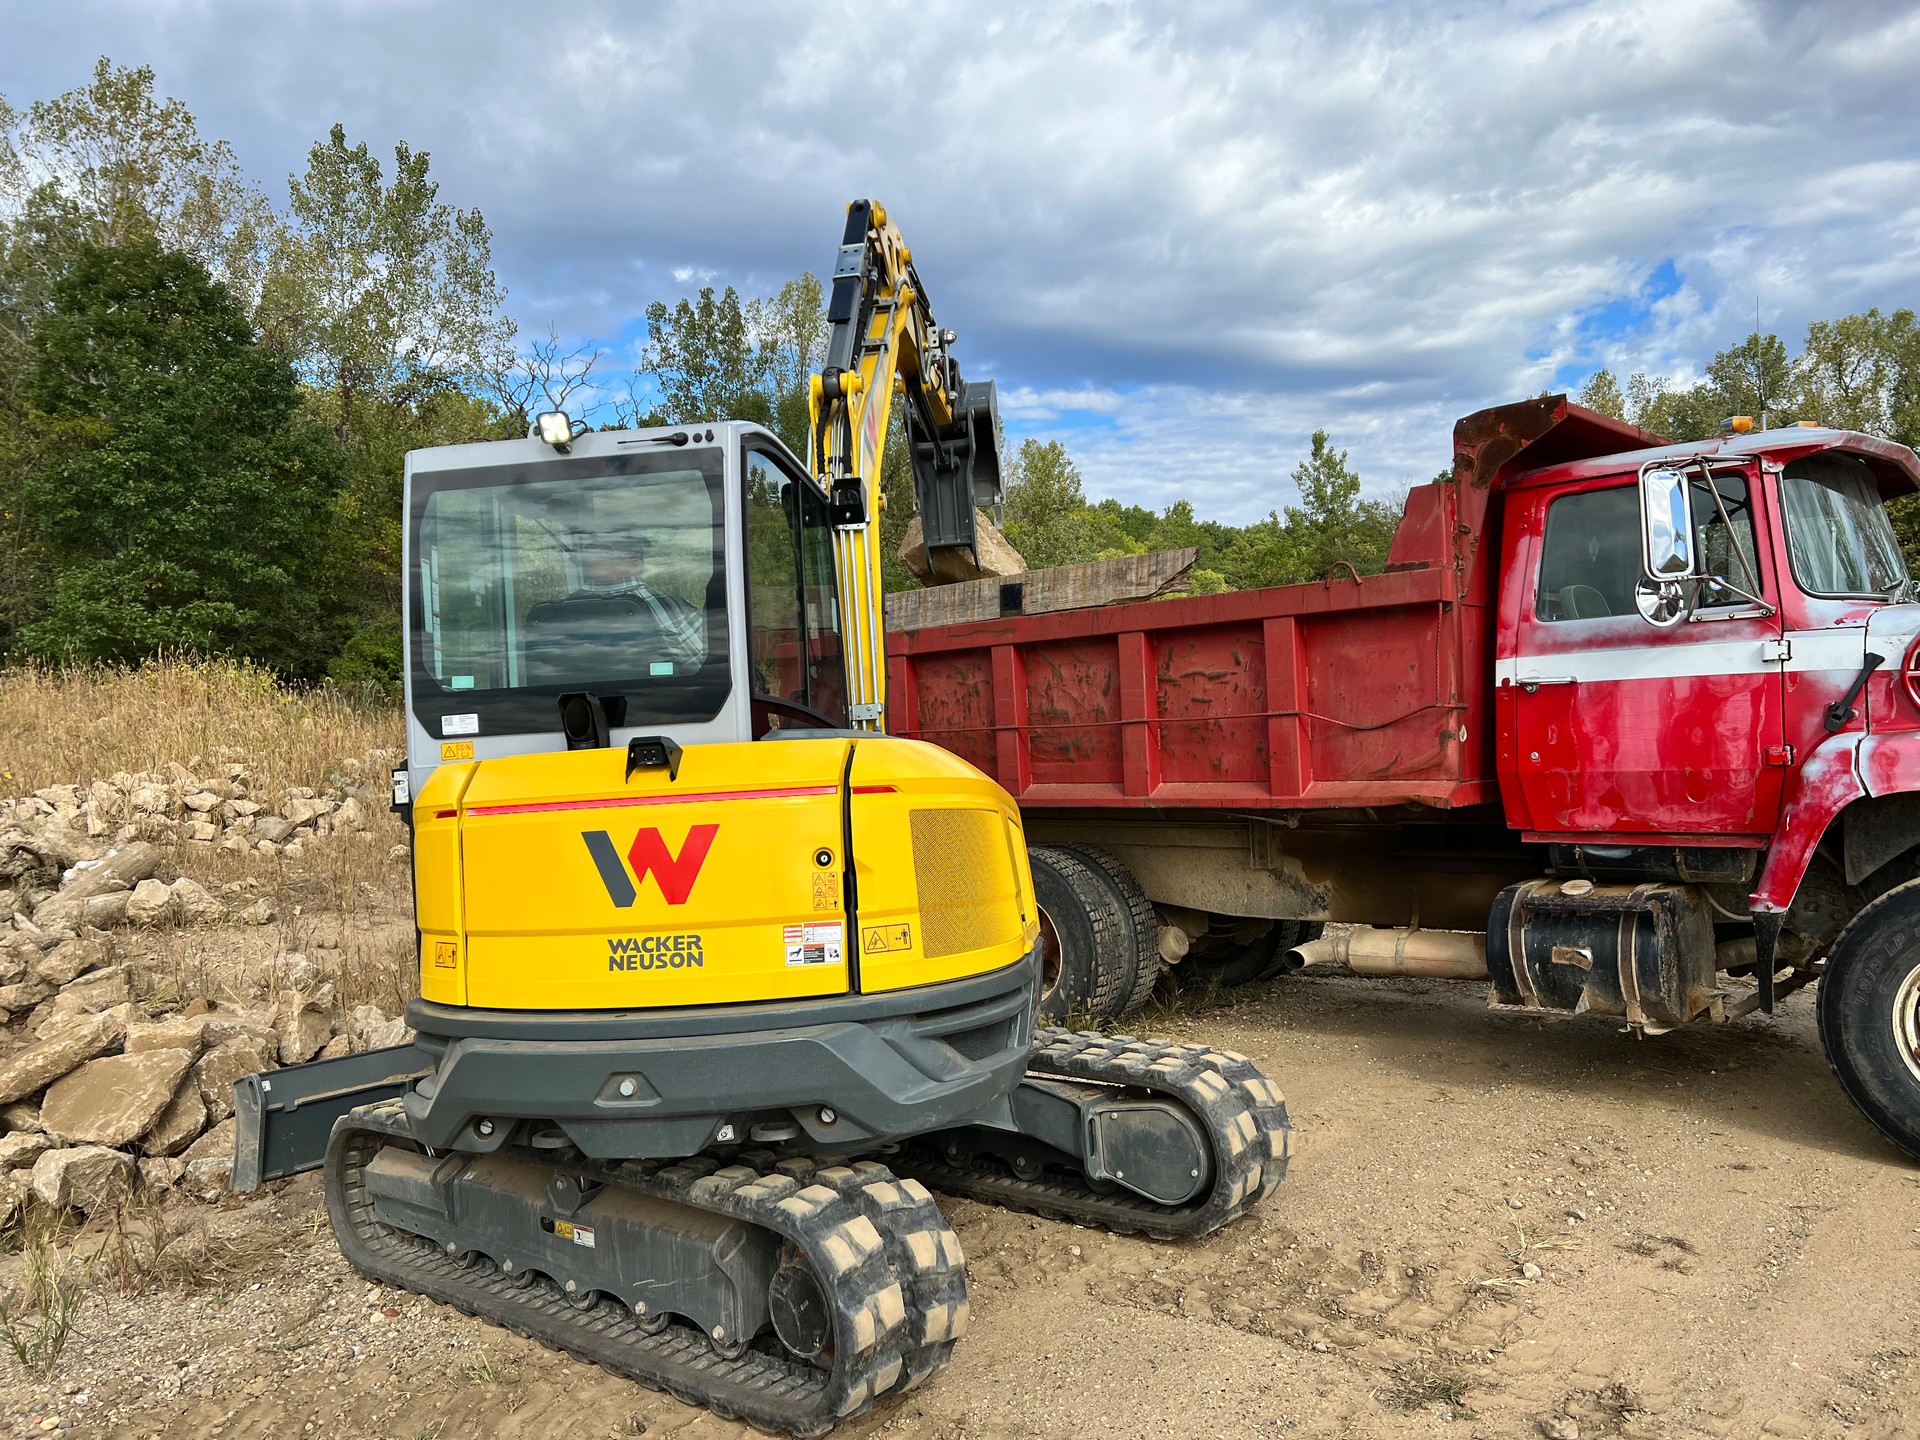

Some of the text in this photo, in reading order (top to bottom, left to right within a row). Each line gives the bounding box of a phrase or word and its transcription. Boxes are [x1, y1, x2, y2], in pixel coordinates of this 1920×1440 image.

[581, 823, 720, 908] W
[607, 934, 703, 955] WACKER
[608, 951, 704, 972] NEUSON
[1855, 957, 1884, 1007] T819
[1883, 932, 1906, 957] LP
